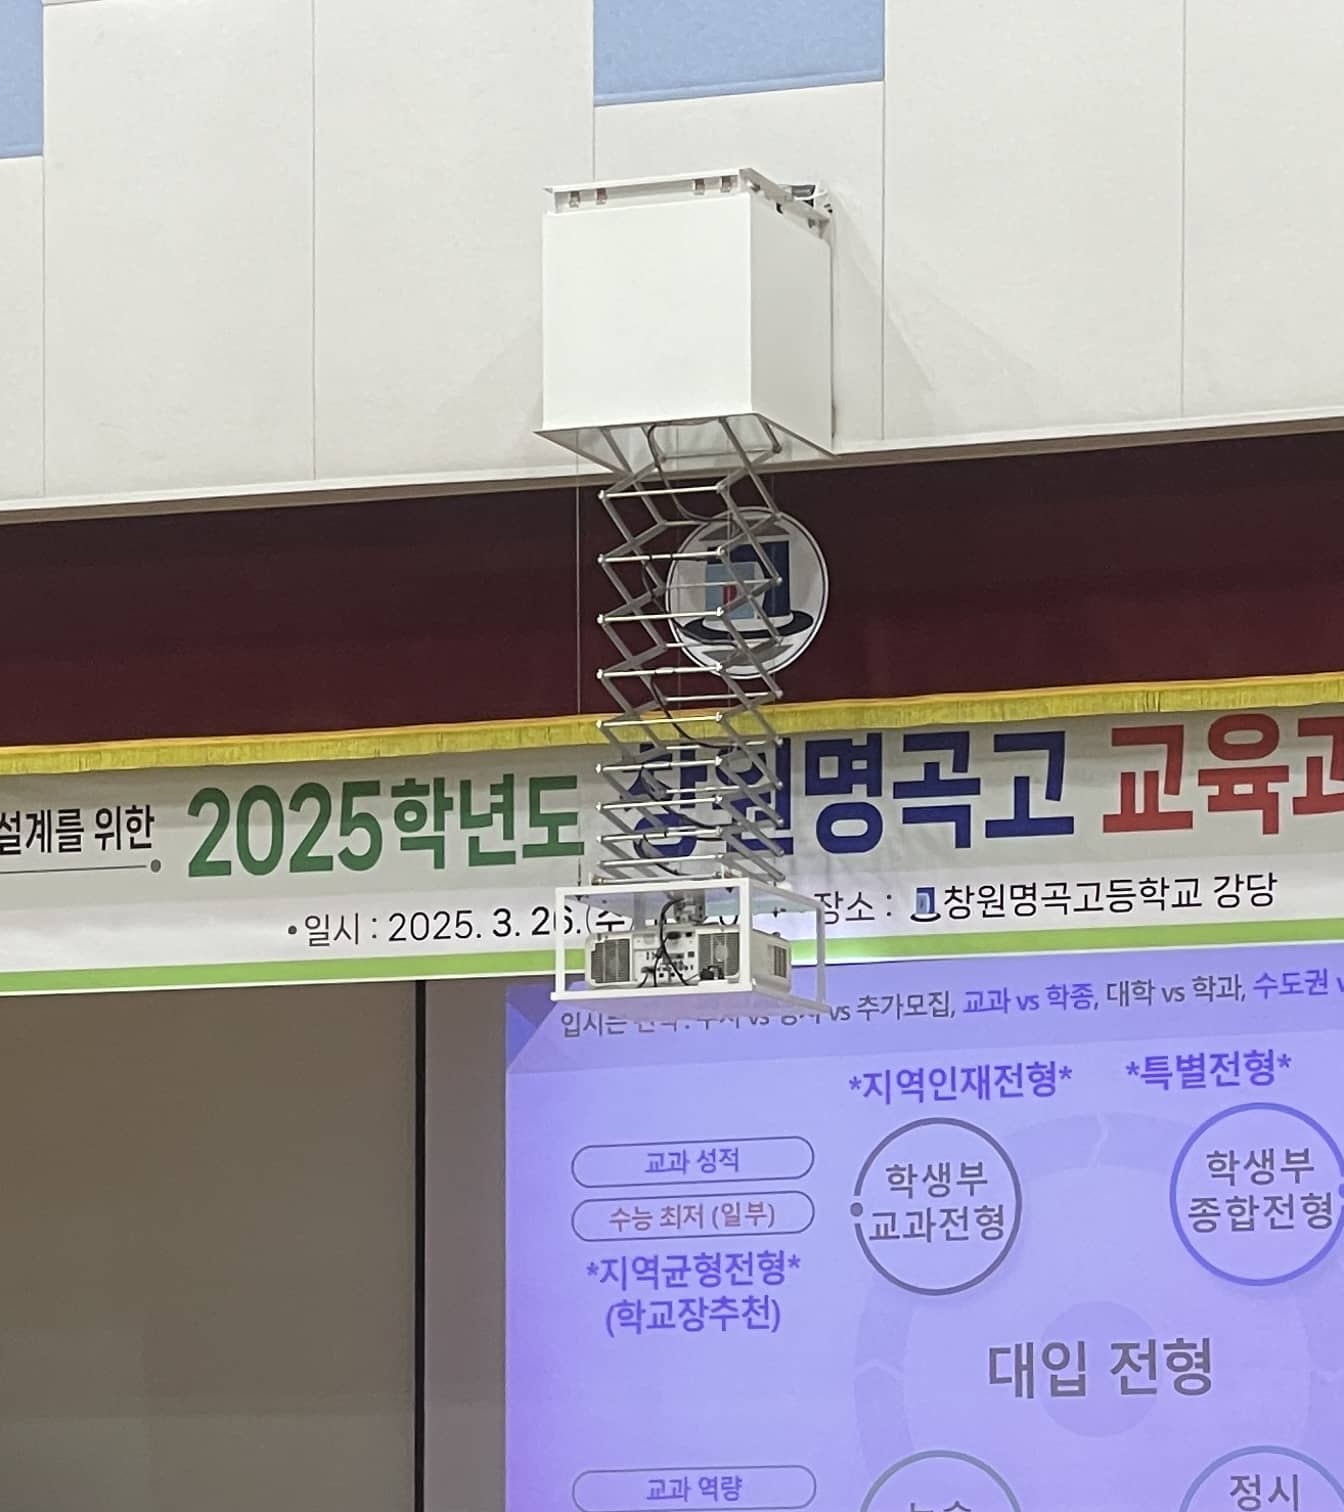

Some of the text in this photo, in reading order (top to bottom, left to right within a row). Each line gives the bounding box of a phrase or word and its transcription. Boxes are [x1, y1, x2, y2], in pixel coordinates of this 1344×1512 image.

[94, 804, 155, 851] 위한
[187, 773, 585, 878] 2025학년도
[304, 911, 360, 948] 일시
[388, 909, 483, 943] 2025.
[492, 906, 522, 938] 3.
[813, 891, 876, 926] 장소
[943, 876, 1203, 921] 창원명곡고등학교
[1212, 871, 1278, 910] 강당
[829, 1005, 852, 1022] vs
[856, 989, 957, 1022] 추가모집,
[962, 988, 1012, 1015] 교과
[1016, 991, 1040, 1011] vs
[1045, 982, 1099, 1013] 학종,
[1105, 978, 1157, 1008] 대학
[1160, 984, 1186, 1003] vs
[1192, 973, 1247, 1004] 학과,
[1252, 967, 1330, 1000] 수도권
[644, 1147, 740, 1175] 교과 성적
[885, 1161, 989, 1199] 학생부
[1205, 1146, 1315, 1187] 학생부
[608, 1201, 776, 1233] 수능 최저 (일부)
[868, 1204, 1006, 1244] 교과전형
[1187, 1192, 1335, 1234] 종합전형
[605, 1294, 782, 1338] (학교장추천)
[988, 1336, 1213, 1400] 대입 전형
[645, 1475, 743, 1504] 교과 역량
[1229, 1472, 1302, 1512] 정시
